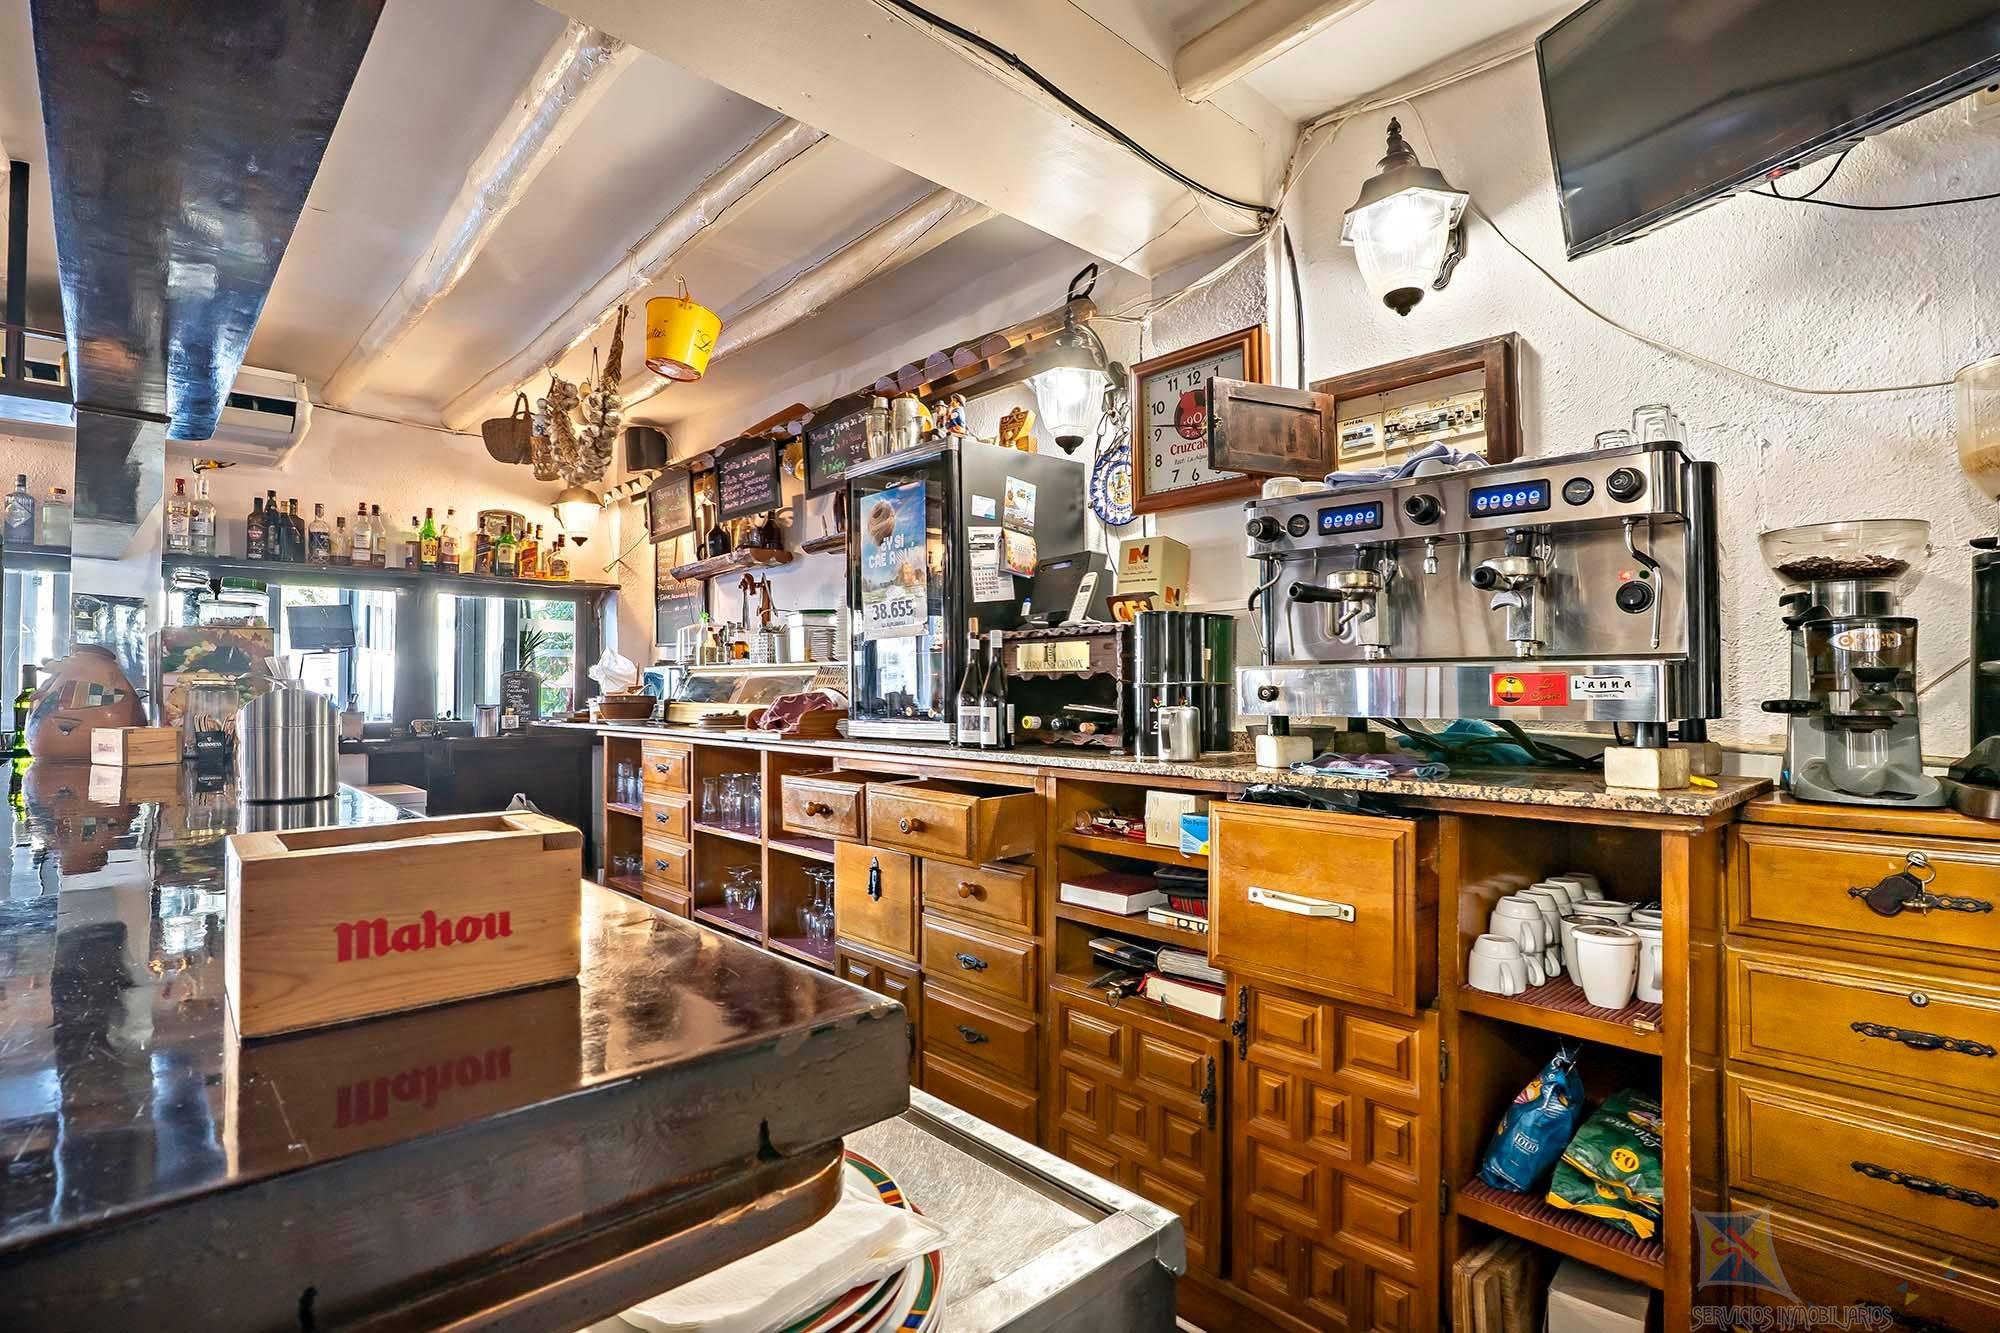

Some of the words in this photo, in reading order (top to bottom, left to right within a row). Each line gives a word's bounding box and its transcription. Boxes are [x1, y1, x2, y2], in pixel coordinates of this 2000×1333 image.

[1167, 377, 1178, 392] 11
[1187, 370, 1201, 386] 12
[1152, 401, 1165, 415] 10
[1154, 428, 1162, 442] 9
[1155, 454, 1162, 467] 8
[1172, 469, 1180, 483] 7
[1191, 468, 1200, 481] 6
[334, 910, 513, 962] Mahou
